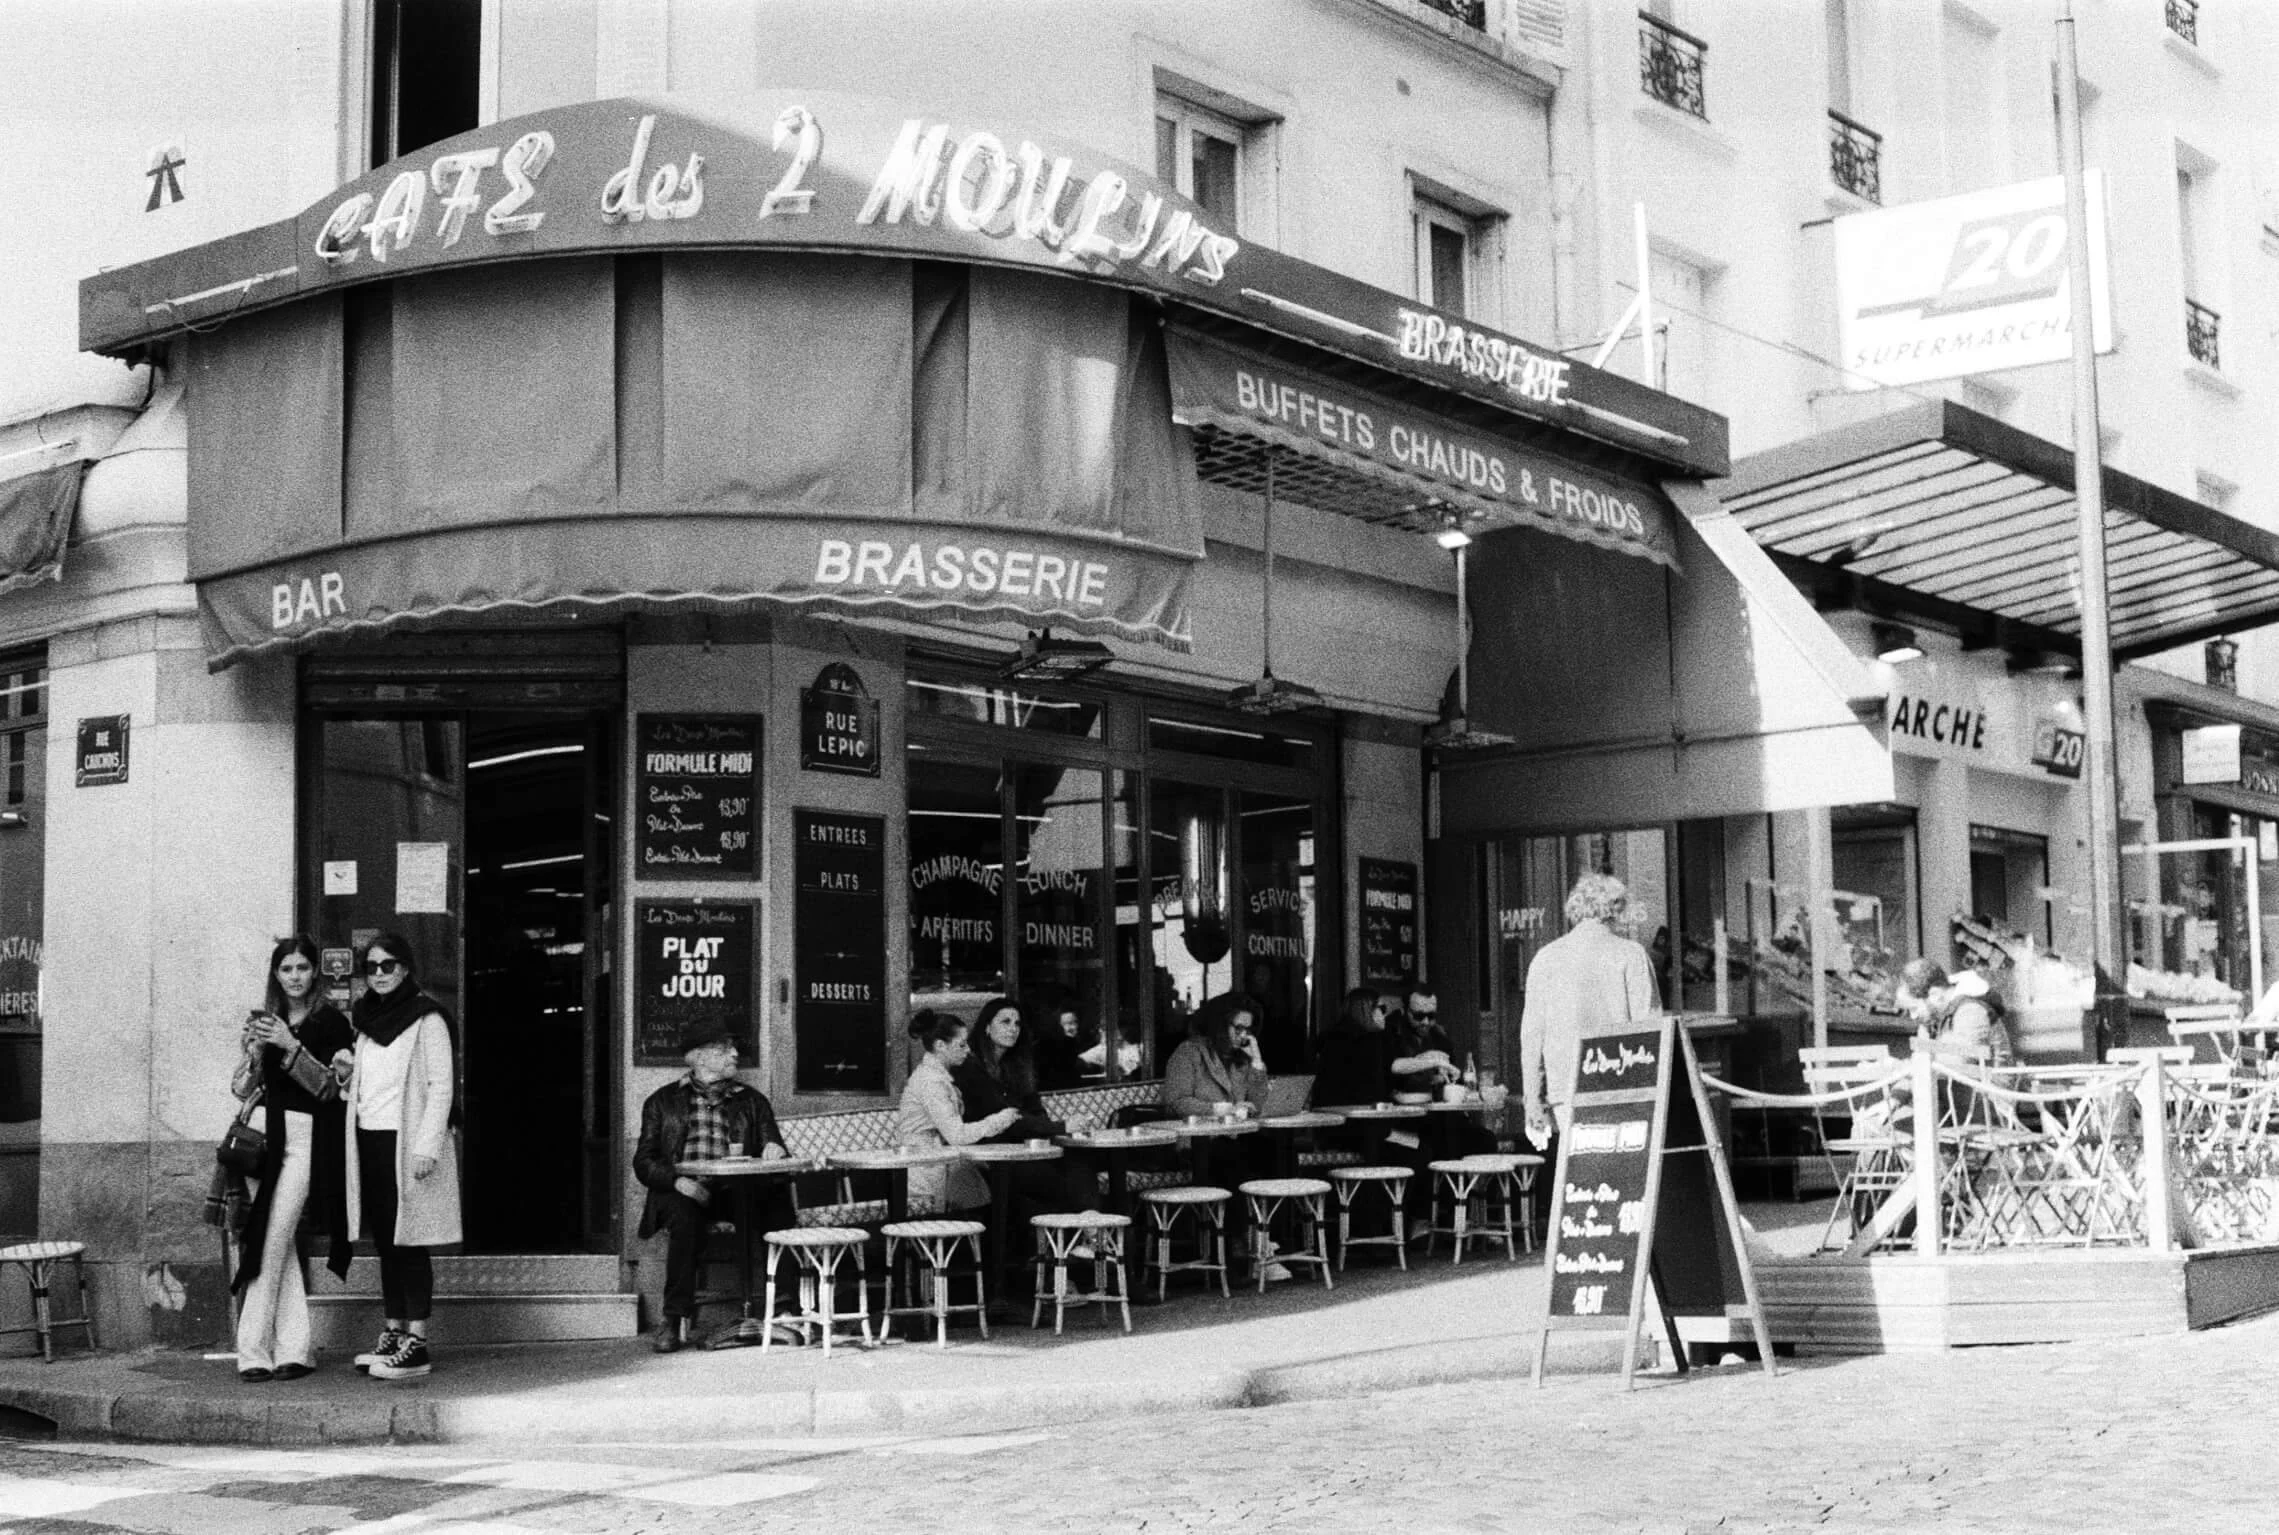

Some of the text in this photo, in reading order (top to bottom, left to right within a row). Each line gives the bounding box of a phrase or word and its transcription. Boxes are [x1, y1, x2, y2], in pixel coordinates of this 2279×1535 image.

[601, 114, 704, 225] des
[759, 104, 823, 219] 2
[1399, 307, 1570, 407] BRASSERIE
[1236, 371, 1643, 534] BUFFETS CHAUDS & FROIDS
[815, 538, 1107, 604] BRASSERIE
[272, 571, 347, 629] BAR
[826, 711, 857, 733] RUE
[819, 734, 866, 758] LEPIC
[646, 752, 716, 774] FORMULE
[810, 824, 867, 845] ENTREES
[820, 871, 859, 890] PLATS
[911, 856, 1003, 896] CHAMPAGNE
[1026, 870, 1088, 898] LUNCH
[920, 913, 993, 943] APÉRITIFS
[1499, 907, 1546, 931] HAPPY
[1025, 922, 1094, 948] DINNER
[662, 937, 725, 959] PLAT
[680, 959, 709, 974] DU
[661, 975, 726, 998] JOUR
[811, 982, 871, 1001] DESSERTS
